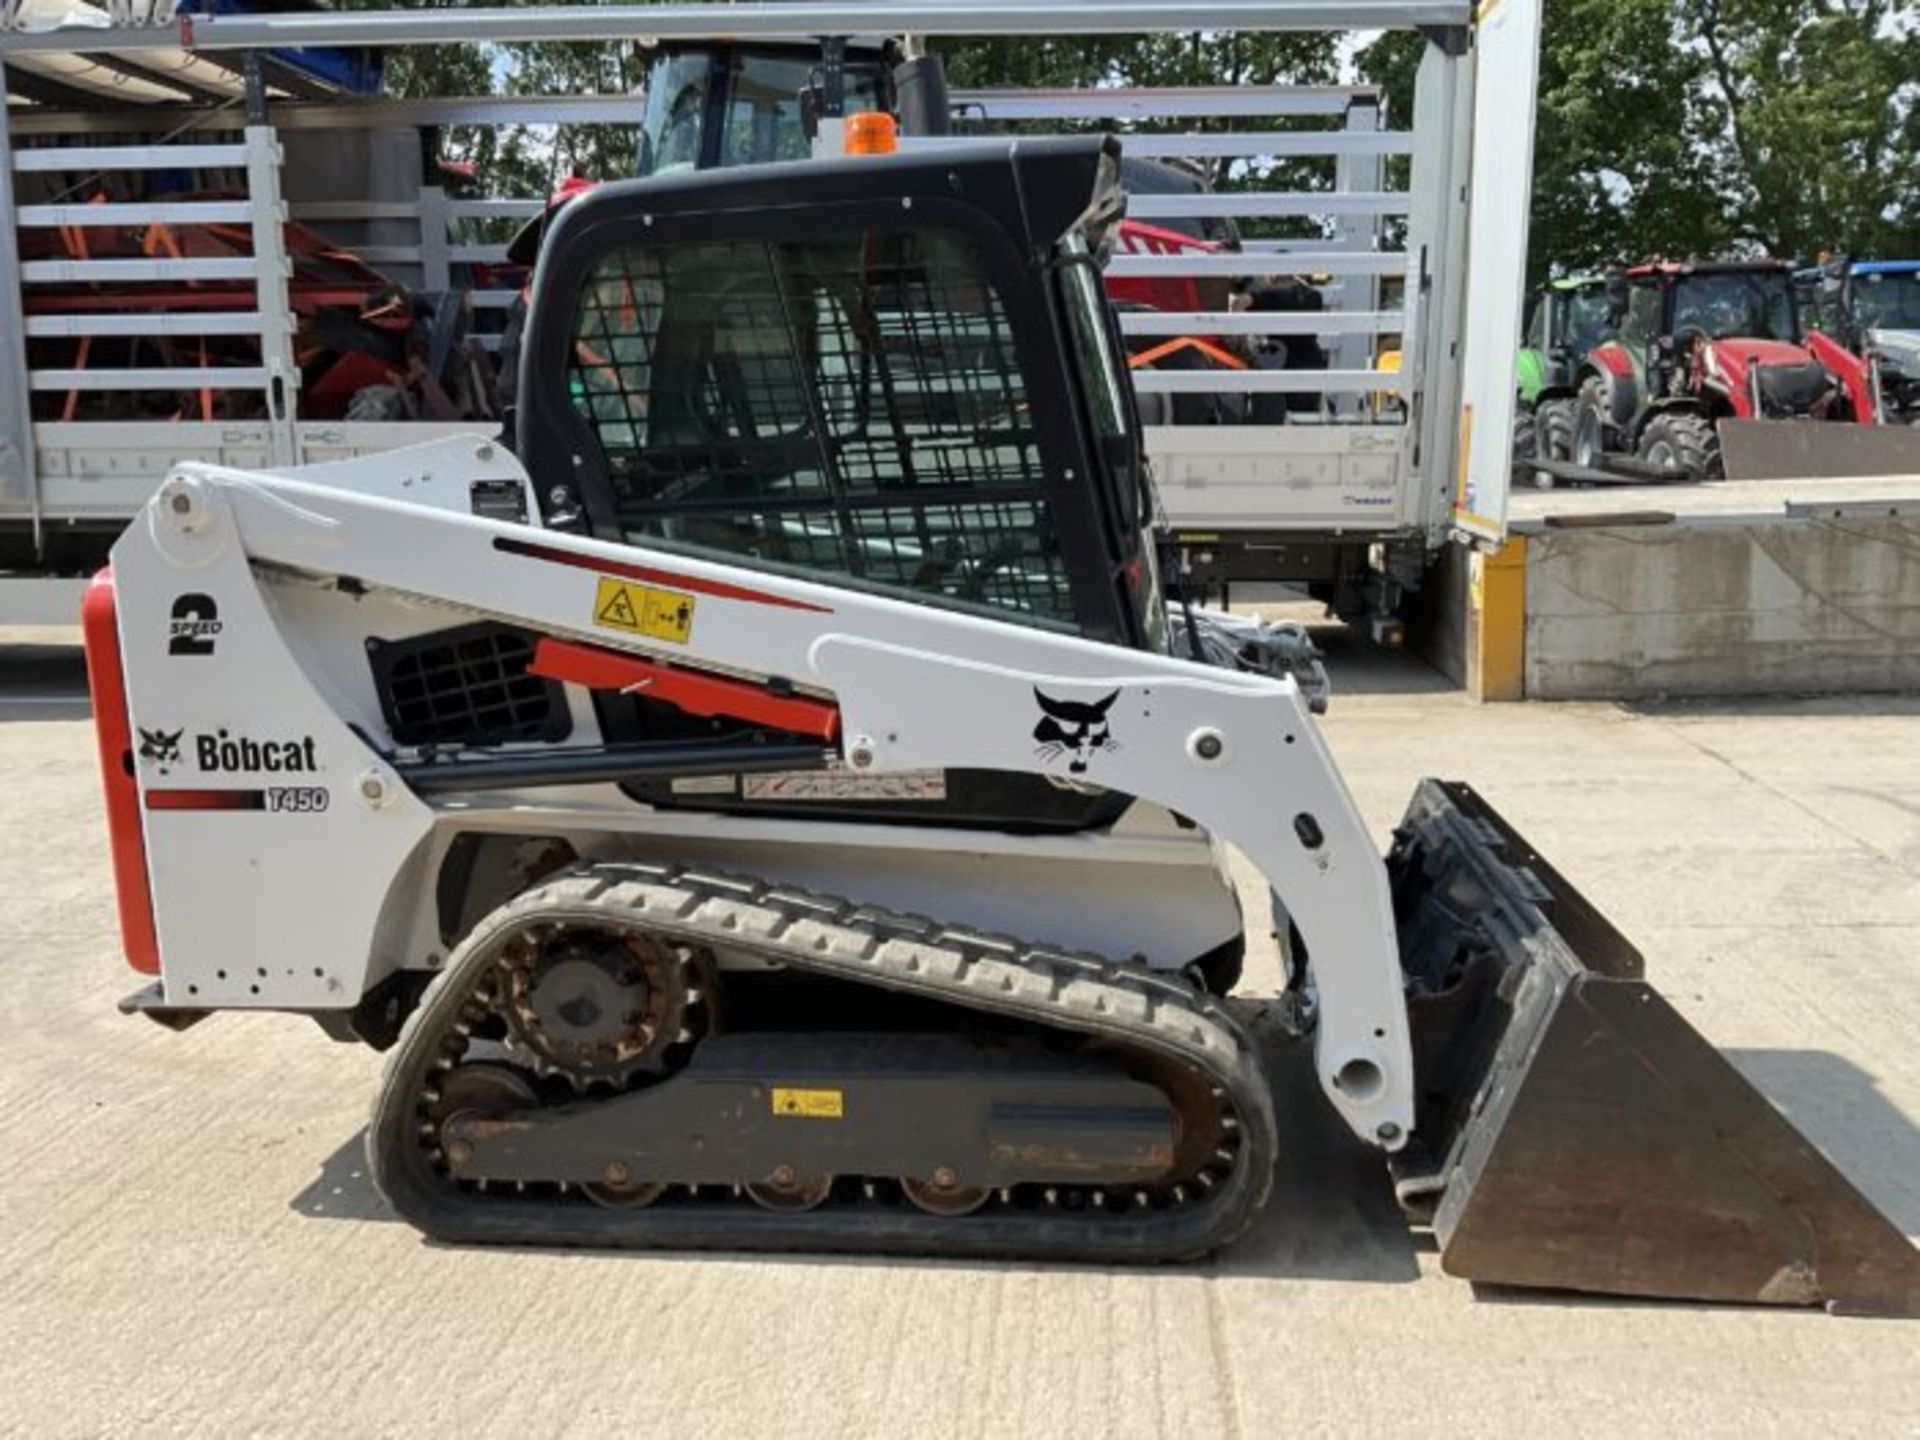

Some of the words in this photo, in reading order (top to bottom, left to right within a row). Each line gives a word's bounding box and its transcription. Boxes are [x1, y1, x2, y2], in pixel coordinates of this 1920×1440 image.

[169, 593, 218, 656] 2
[170, 621, 223, 635] SPEED
[197, 735, 317, 772] Bobcat
[268, 787, 330, 812] T450
